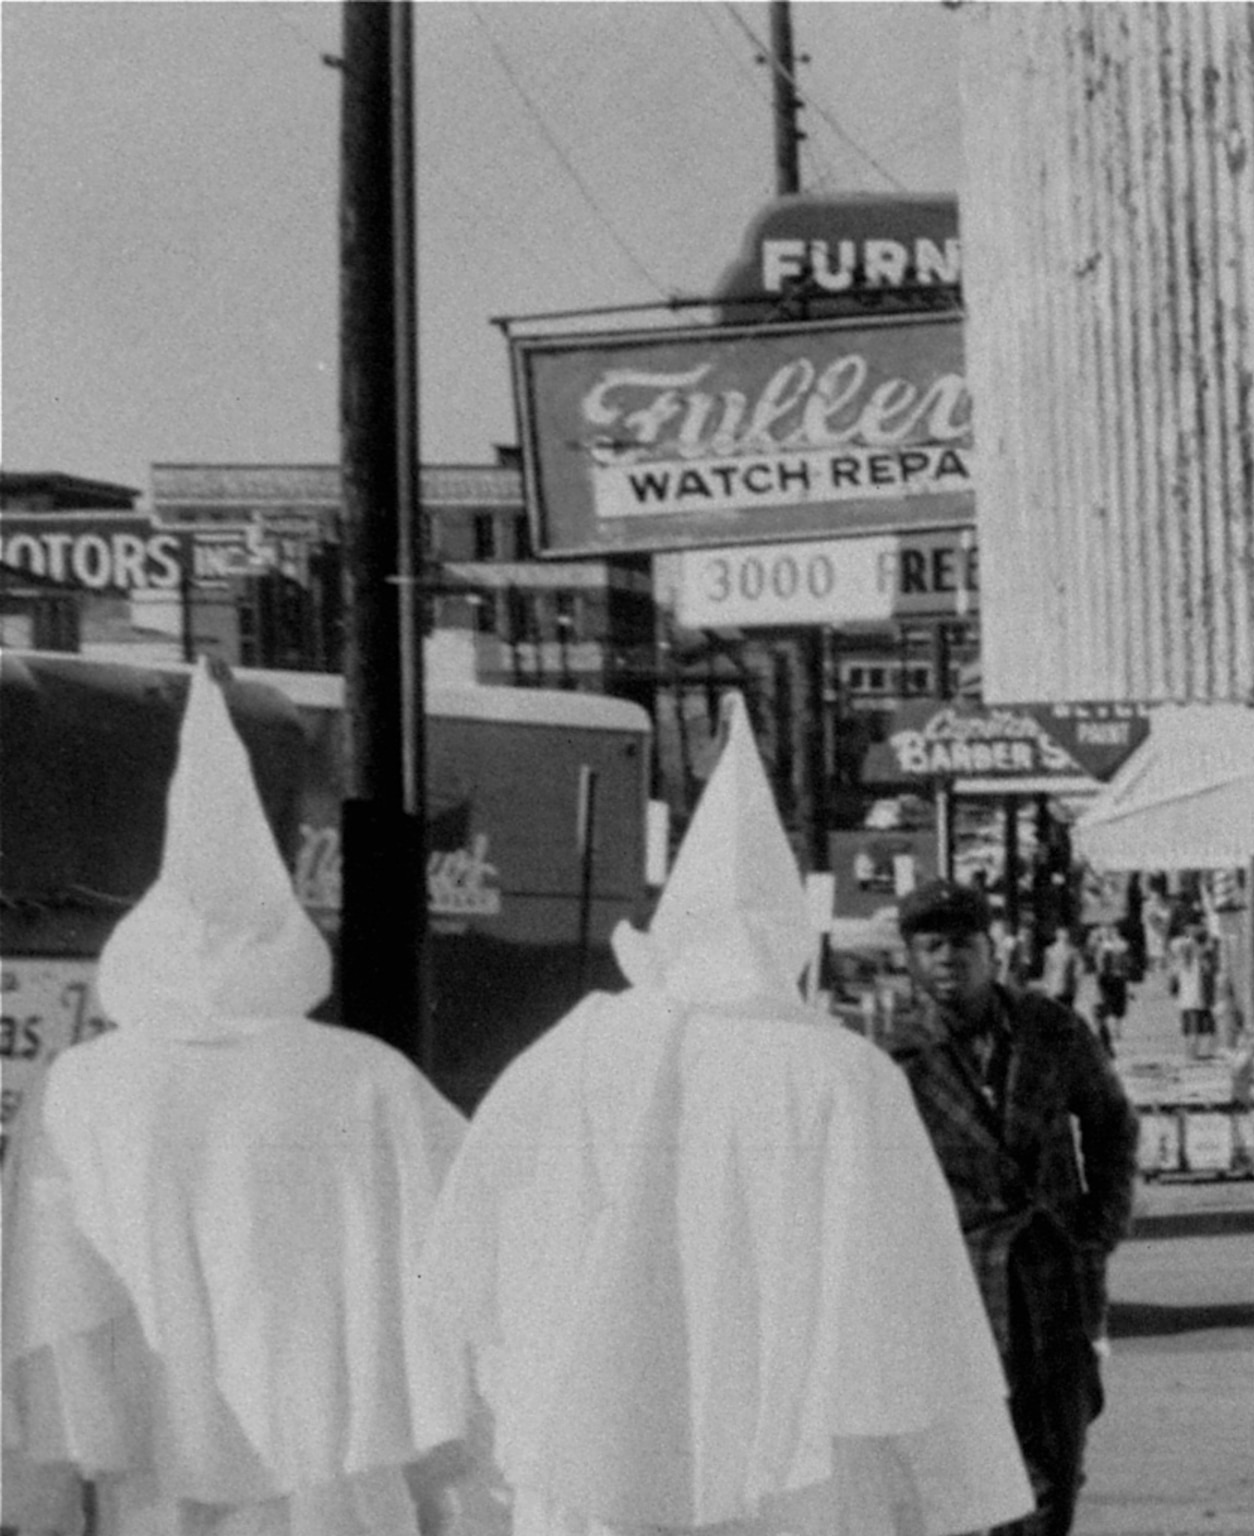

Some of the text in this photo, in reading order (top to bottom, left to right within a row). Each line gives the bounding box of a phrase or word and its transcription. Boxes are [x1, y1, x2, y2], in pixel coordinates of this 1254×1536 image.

[762, 238, 960, 291] FURN
[582, 353, 971, 460] Fuller
[629, 449, 970, 503] WATCH REPA
[706, 555, 834, 602] 3000
[889, 730, 1080, 772] BARBER S
